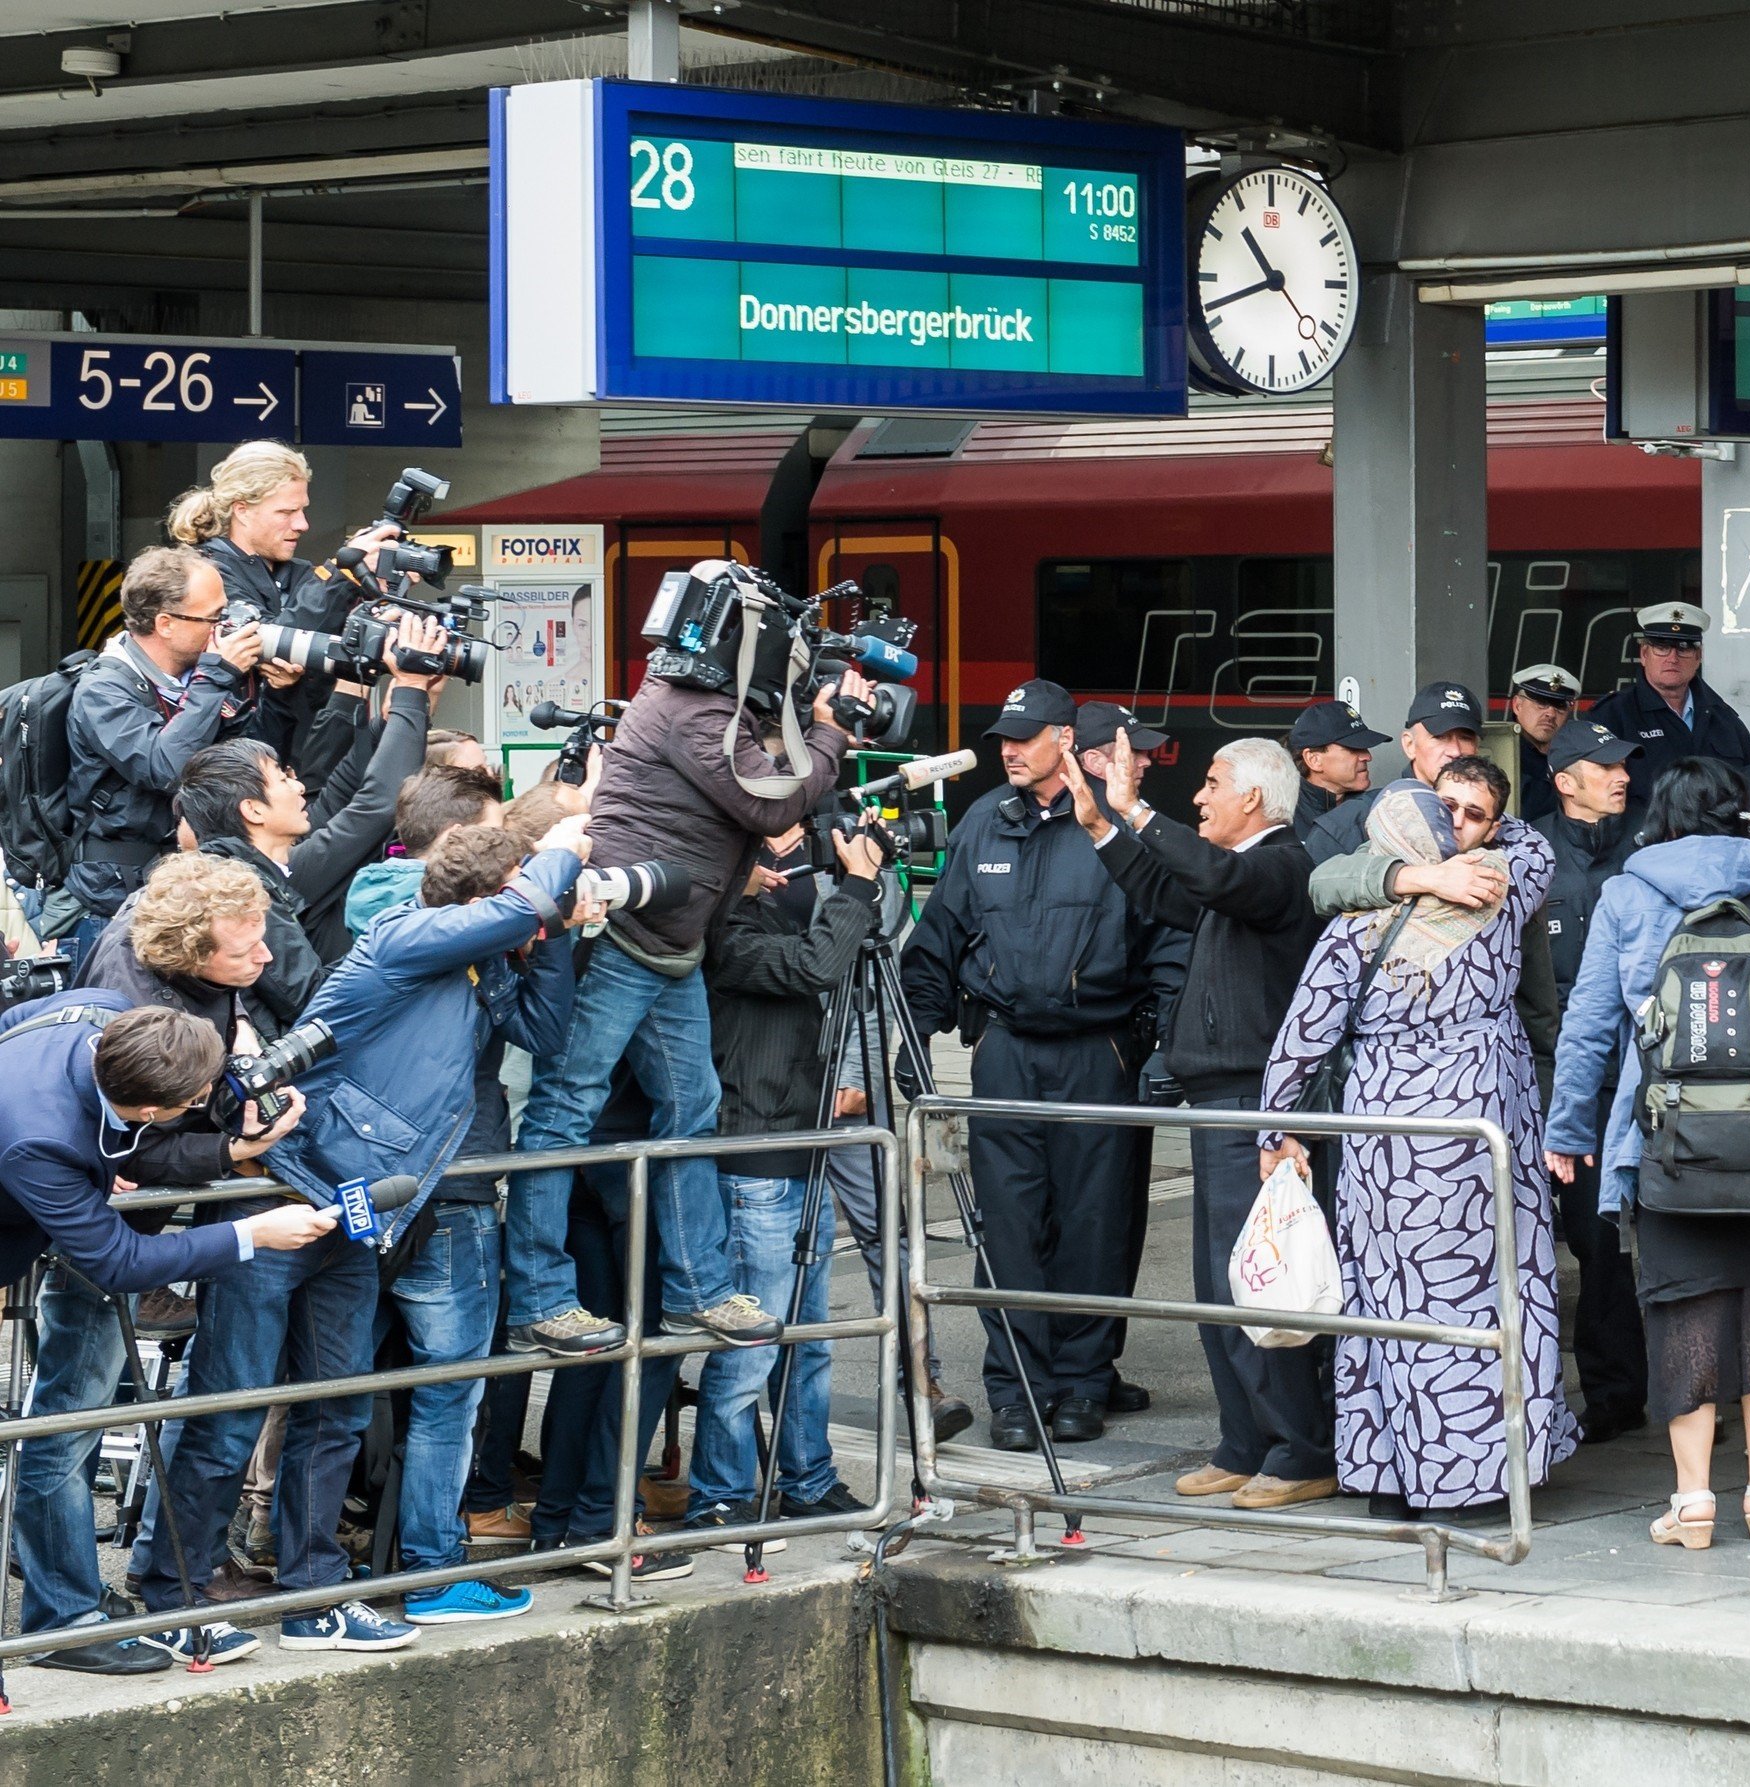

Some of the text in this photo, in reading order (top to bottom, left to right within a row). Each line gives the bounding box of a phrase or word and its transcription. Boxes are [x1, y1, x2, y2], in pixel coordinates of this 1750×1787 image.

[630, 139, 695, 211] 28
[832, 151, 886, 172] heute
[894, 159, 925, 175] von
[933, 159, 975, 179] Gleis
[983, 163, 1000, 180] 27
[1063, 182, 1136, 218] 11:00
[1089, 224, 1136, 243] S 8452
[740, 294, 1034, 346] Donnersbergerbrück
[78, 350, 214, 413] 5-26
[502, 591, 570, 601] PASSBILDER
[929, 759, 963, 773] REUTERS
[977, 862, 1011, 874] POLIZEI
[1708, 980, 1719, 1023] OUTDOOR
[347, 1189, 368, 1228] TVP
